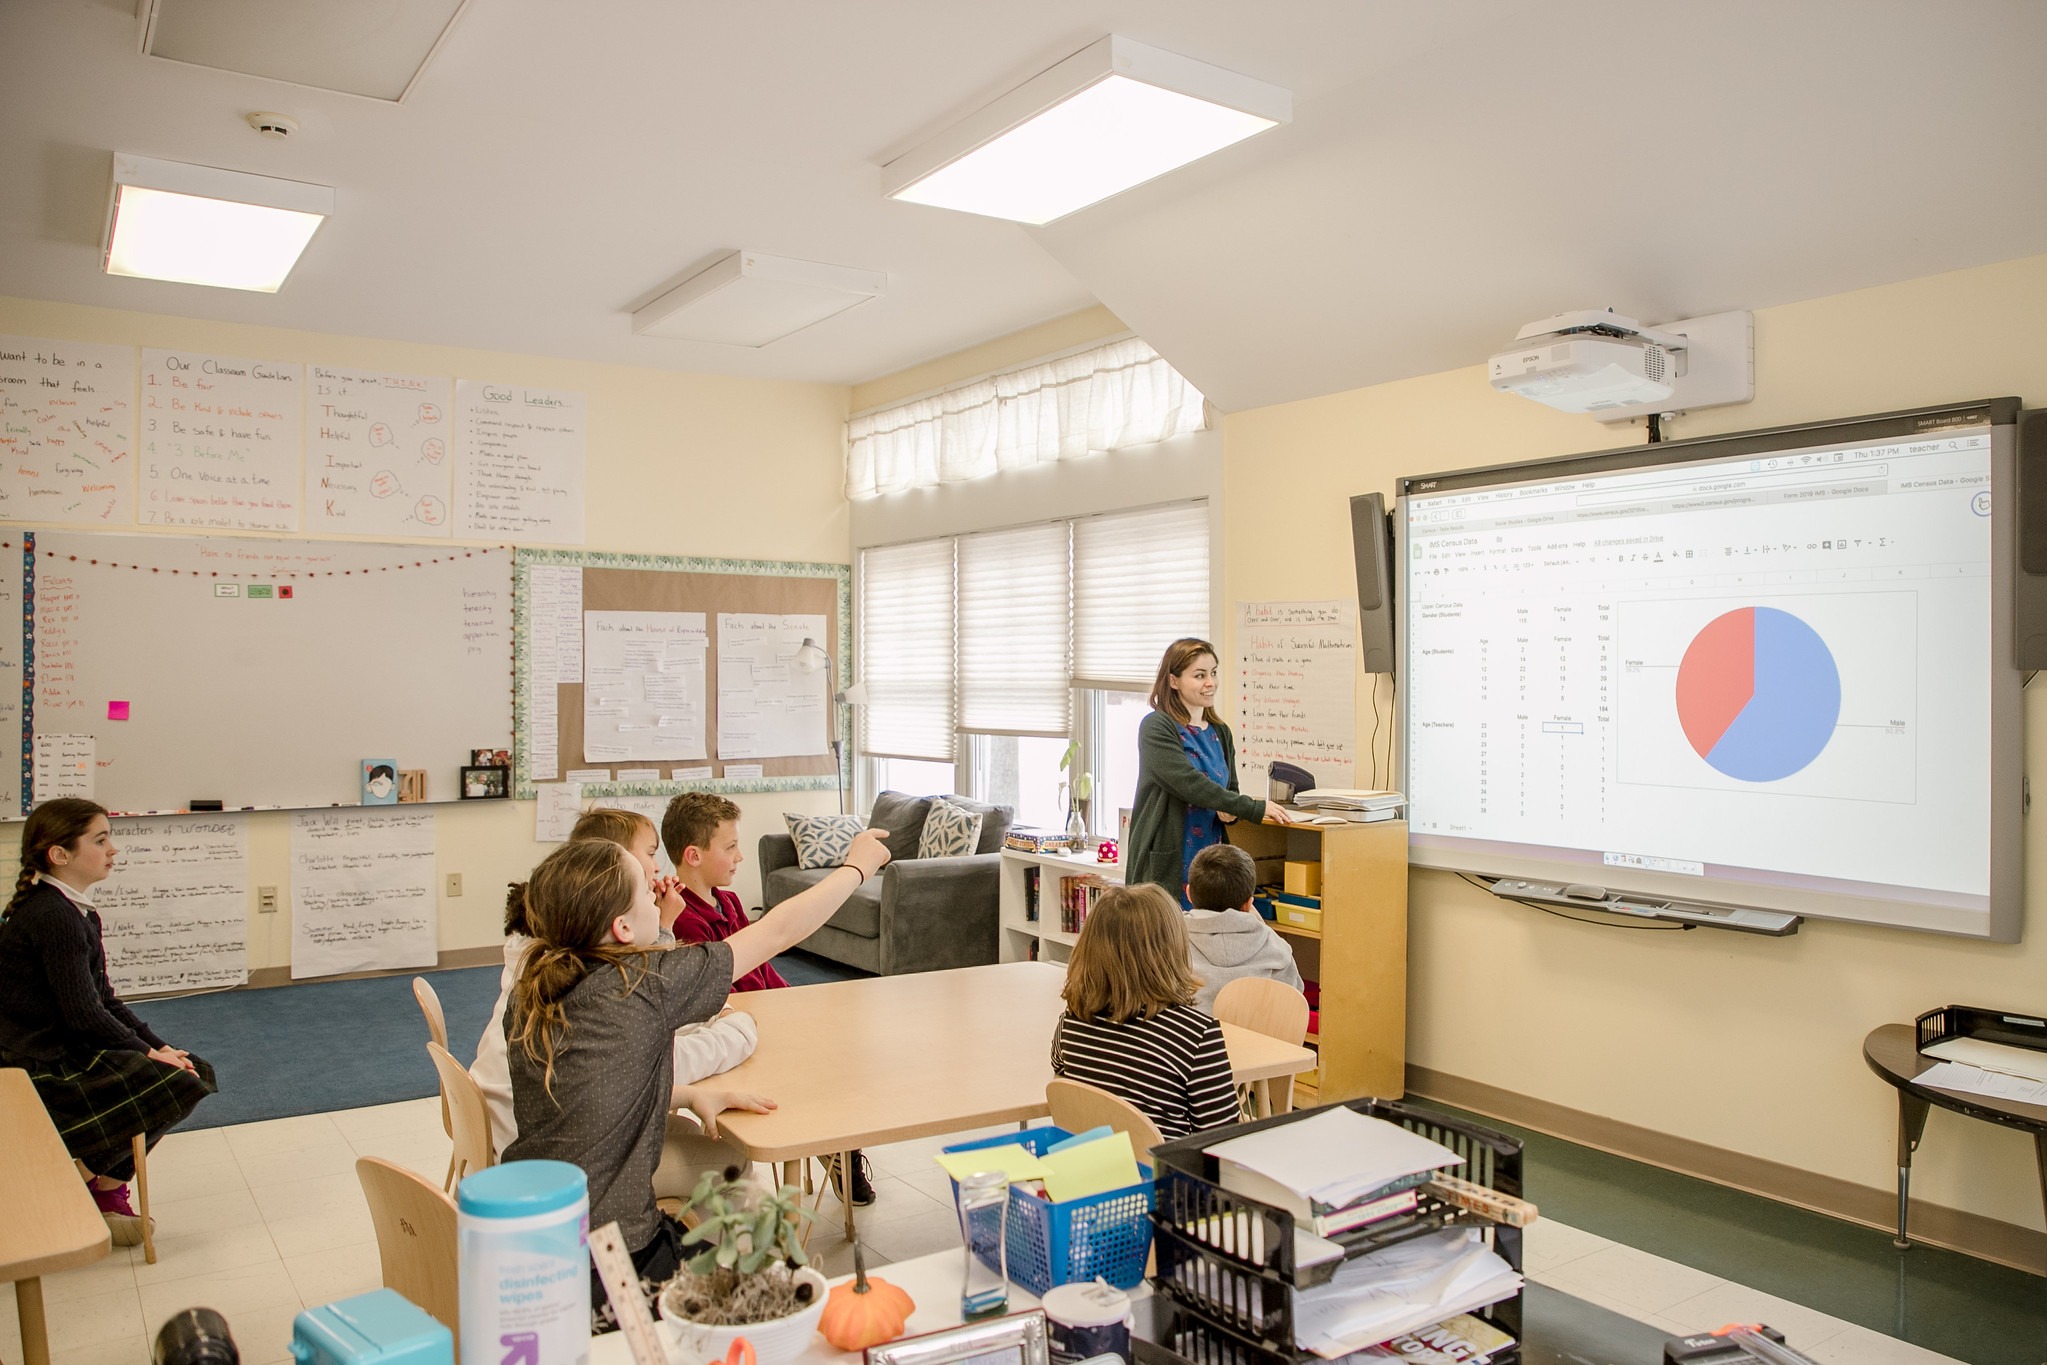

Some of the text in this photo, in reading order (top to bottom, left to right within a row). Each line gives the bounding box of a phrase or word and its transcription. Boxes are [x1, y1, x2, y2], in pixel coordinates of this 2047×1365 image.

[0, 352, 26, 361] Want
[35, 353, 47, 364] to
[52, 353, 66, 366] be
[166, 357, 191, 370] Our
[1523, 355, 1539, 363] EPSON
[40, 377, 60, 388] that
[172, 376, 188, 389] Be
[482, 385, 512, 401] Good
[4, 397, 18, 407] fun
[172, 398, 186, 410] Be
[321, 405, 367, 422] Thoughtful
[172, 421, 186, 434] Be
[231, 428, 251, 440] have
[320, 426, 350, 441] Helpful
[1854, 444, 1940, 459] Thu 1:37 PM teacher
[171, 467, 192, 480] One
[226, 476, 237, 484] at
[241, 477, 249, 485] a
[1901, 474, 1983, 488] IMS Census Data Google
[1421, 481, 1437, 490] SMART
[1495, 491, 1513, 499] History
[1519, 487, 1548, 496] Bookmarks
[1554, 484, 1575, 492] Window
[1582, 481, 1595, 489] Help
[1699, 481, 1746, 492] docs.google.com
[1831, 487, 1852, 496] Google
[165, 511, 178, 524] Be
[43, 576, 72, 584] Falcons
[596, 621, 614, 632] Facts
[646, 622, 666, 632] House
[725, 617, 744, 630] Facts
[782, 619, 809, 630] Senate
[110, 822, 153, 836] haracters
[500, 1265, 578, 1290] disinfecting
[500, 1291, 543, 1305] wipes
